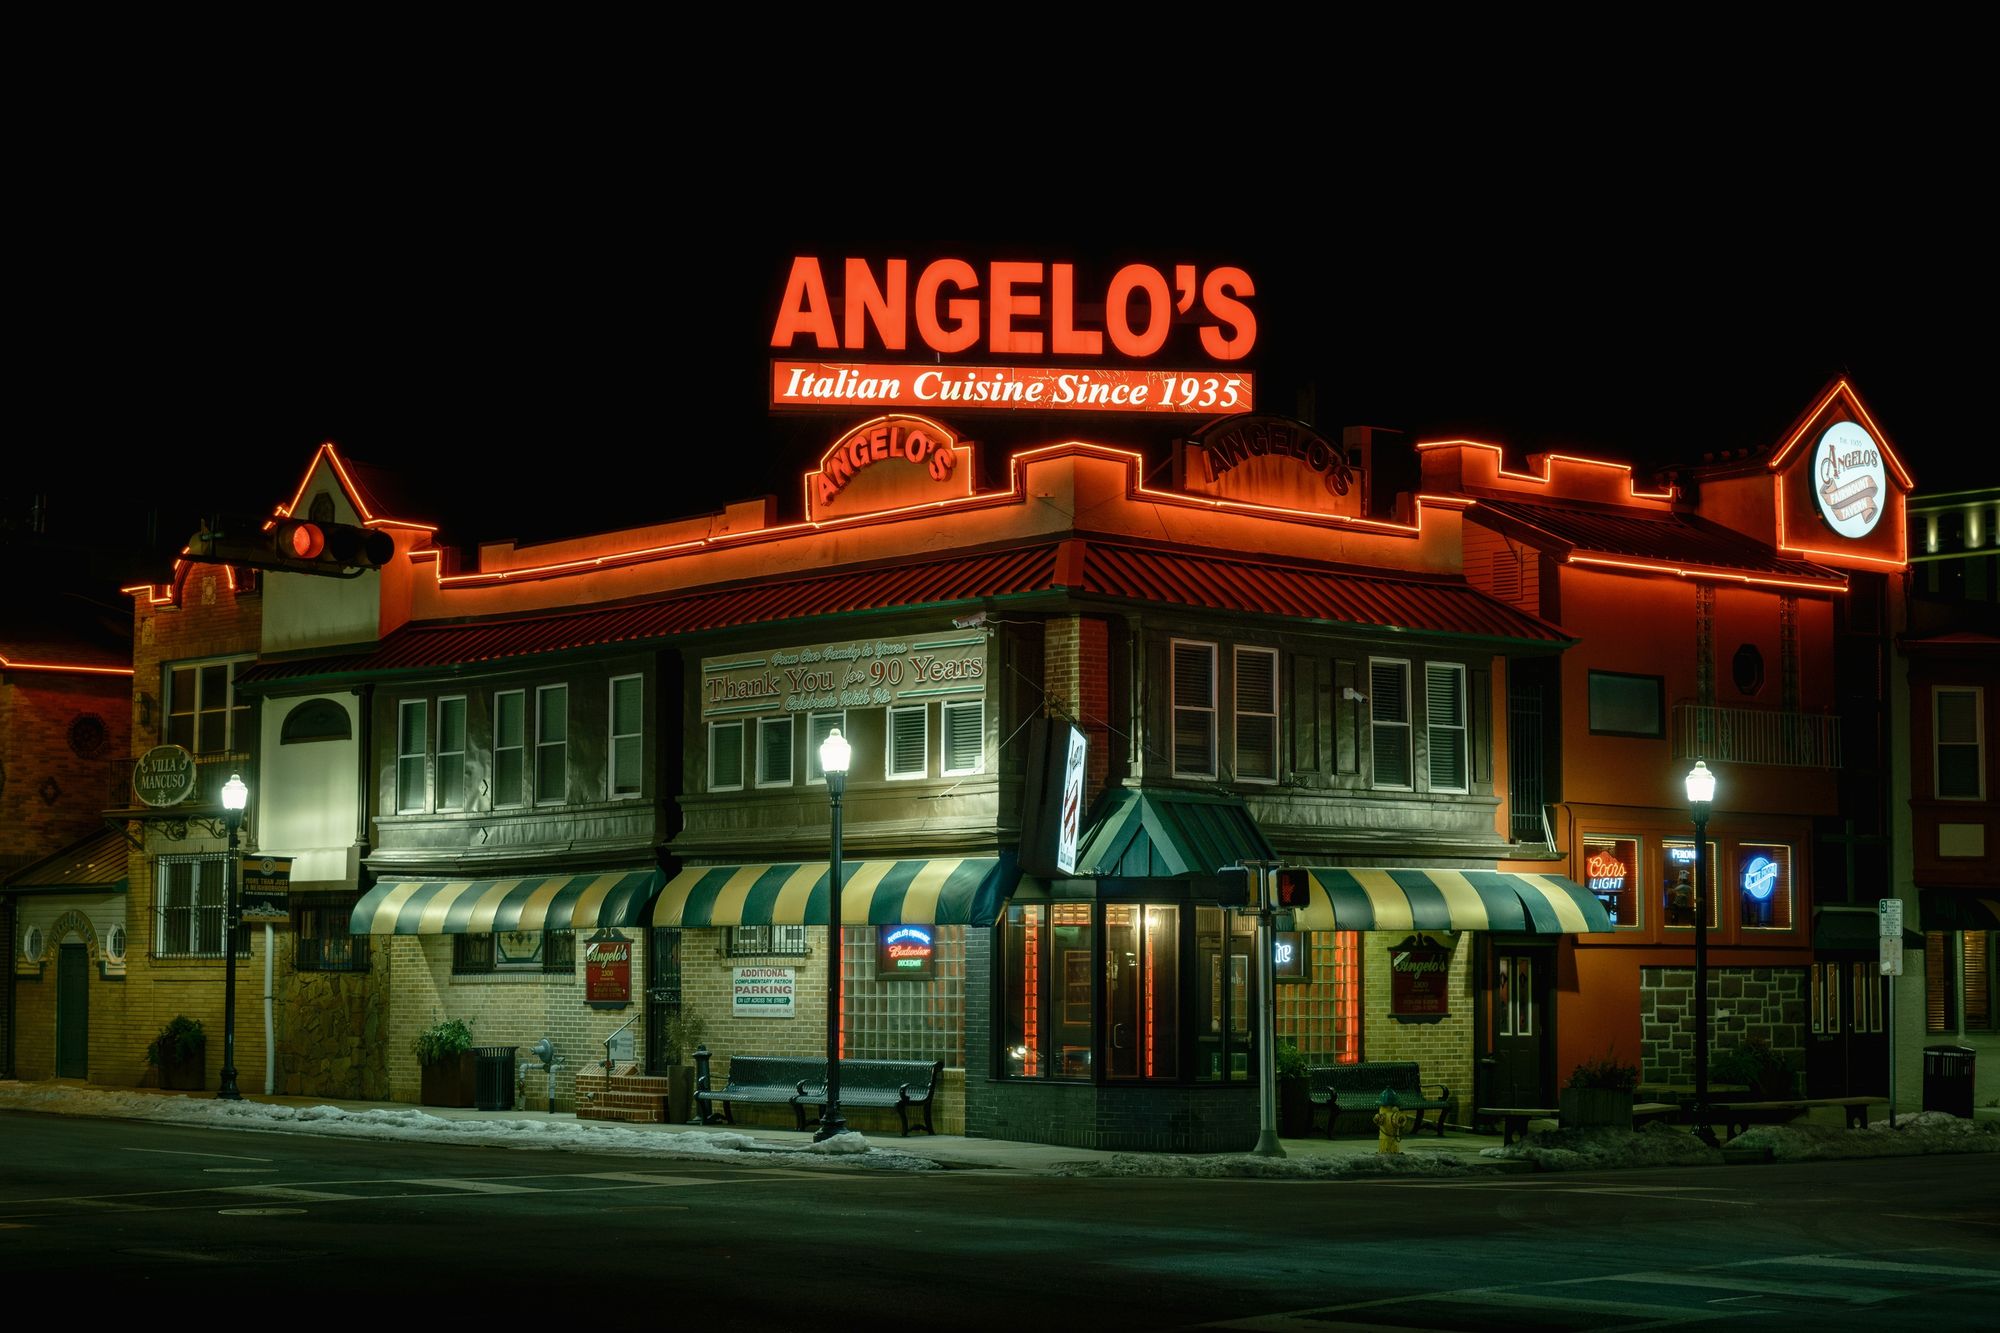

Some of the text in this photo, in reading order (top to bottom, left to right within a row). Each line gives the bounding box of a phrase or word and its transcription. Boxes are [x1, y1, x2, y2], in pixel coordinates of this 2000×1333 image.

[770, 256, 1257, 360] ANGELO'S
[783, 368, 1241, 408] Italian Cuisine Since 1935
[817, 426, 957, 506] ANGELO'S
[1203, 423, 1354, 496] ANGELO'S
[1820, 444, 1878, 484] ANGELO'S
[1840, 497, 1868, 519] TAVERN
[771, 641, 907, 666] From Our Family to Yours
[706, 654, 984, 701] Thank You for 90 Years
[784, 687, 892, 711] Celebrate With Us
[152, 758, 176, 772] VILLA
[141, 773, 185, 789] MANCUSO
[1589, 856, 1627, 877] Coors
[1592, 877, 1624, 890] LIGHT
[587, 943, 628, 968] Angelo's
[888, 945, 931, 958] Budweiser
[741, 968, 787, 977] ADDITIONAL
[1395, 953, 1446, 979] Angelo's
[735, 985, 792, 994] PARKING
